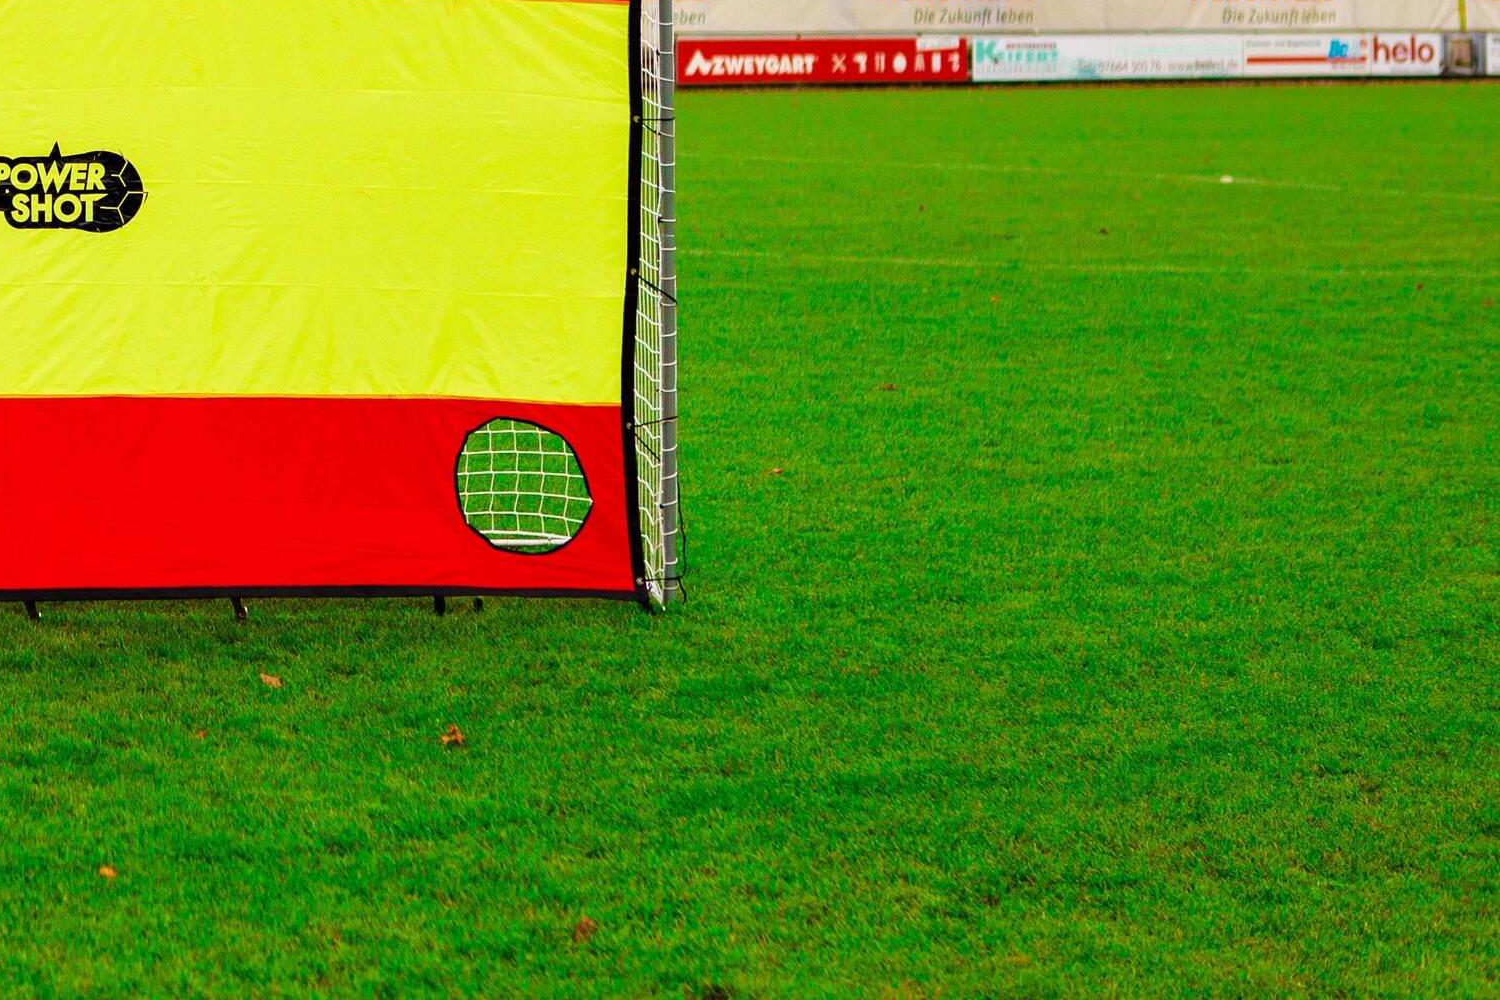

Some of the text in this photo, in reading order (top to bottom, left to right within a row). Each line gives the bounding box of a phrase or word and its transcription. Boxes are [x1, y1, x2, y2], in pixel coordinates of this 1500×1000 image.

[673, 10, 706, 25] eben
[914, 8, 1034, 26] Die Zukunft leben
[1222, 8, 1336, 26] Die Zukunft leben
[1372, 35, 1436, 64] helo
[10, 193, 108, 223] SHOT
